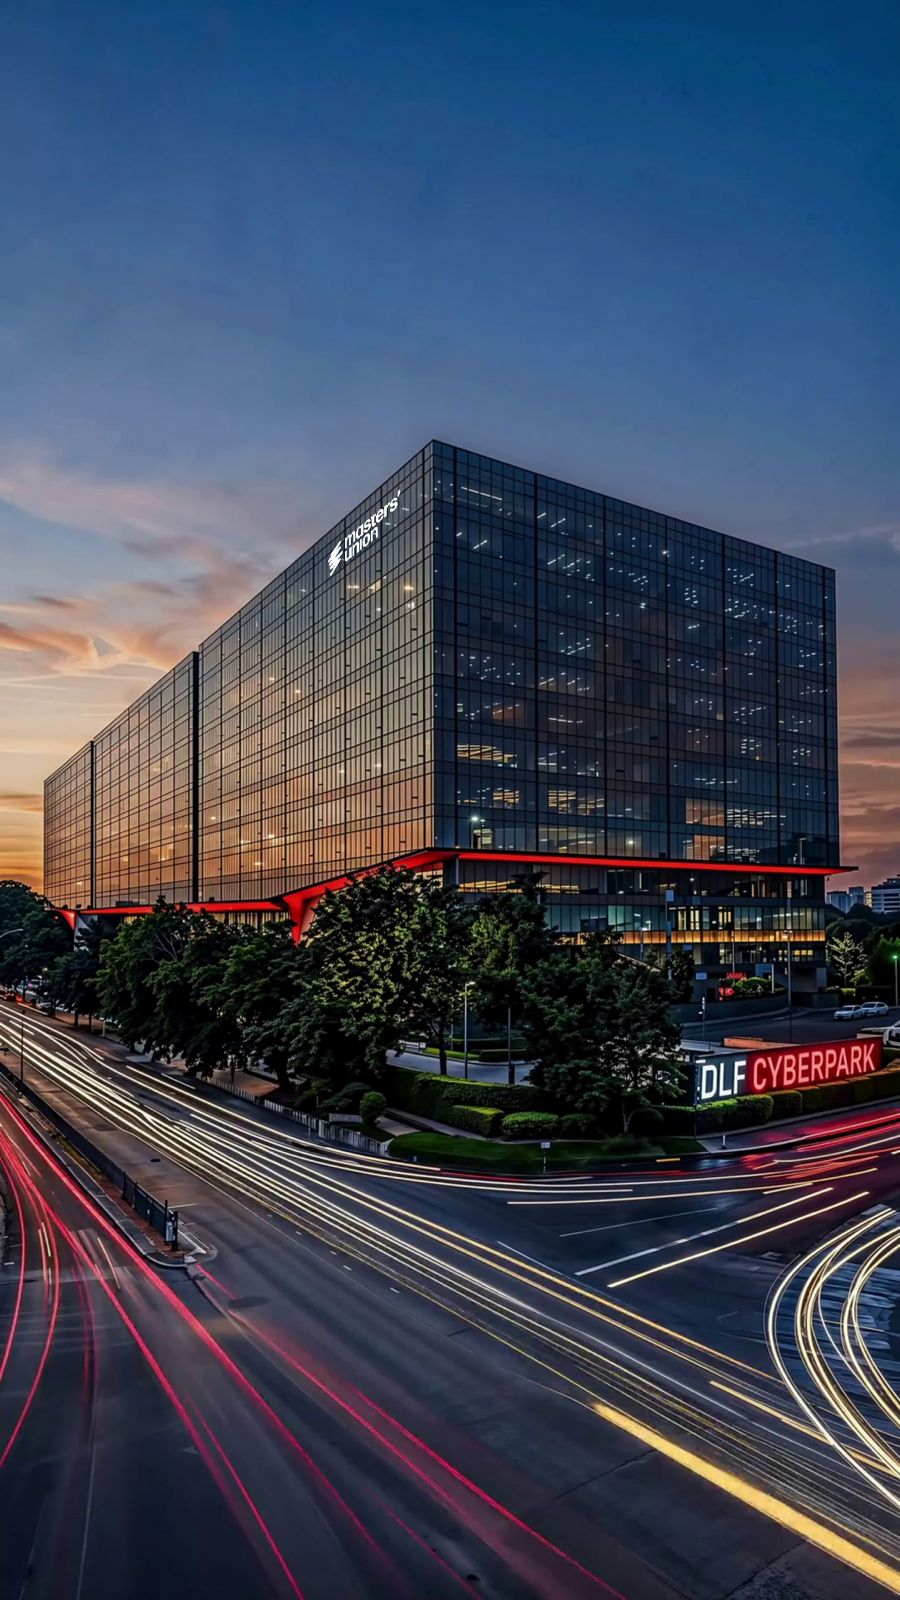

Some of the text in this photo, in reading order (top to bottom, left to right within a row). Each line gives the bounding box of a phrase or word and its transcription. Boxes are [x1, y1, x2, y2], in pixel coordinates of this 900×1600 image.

[345, 490, 400, 549] masters'
[345, 526, 378, 561] union
[701, 1043, 875, 1099] DLF CYBERPARK
